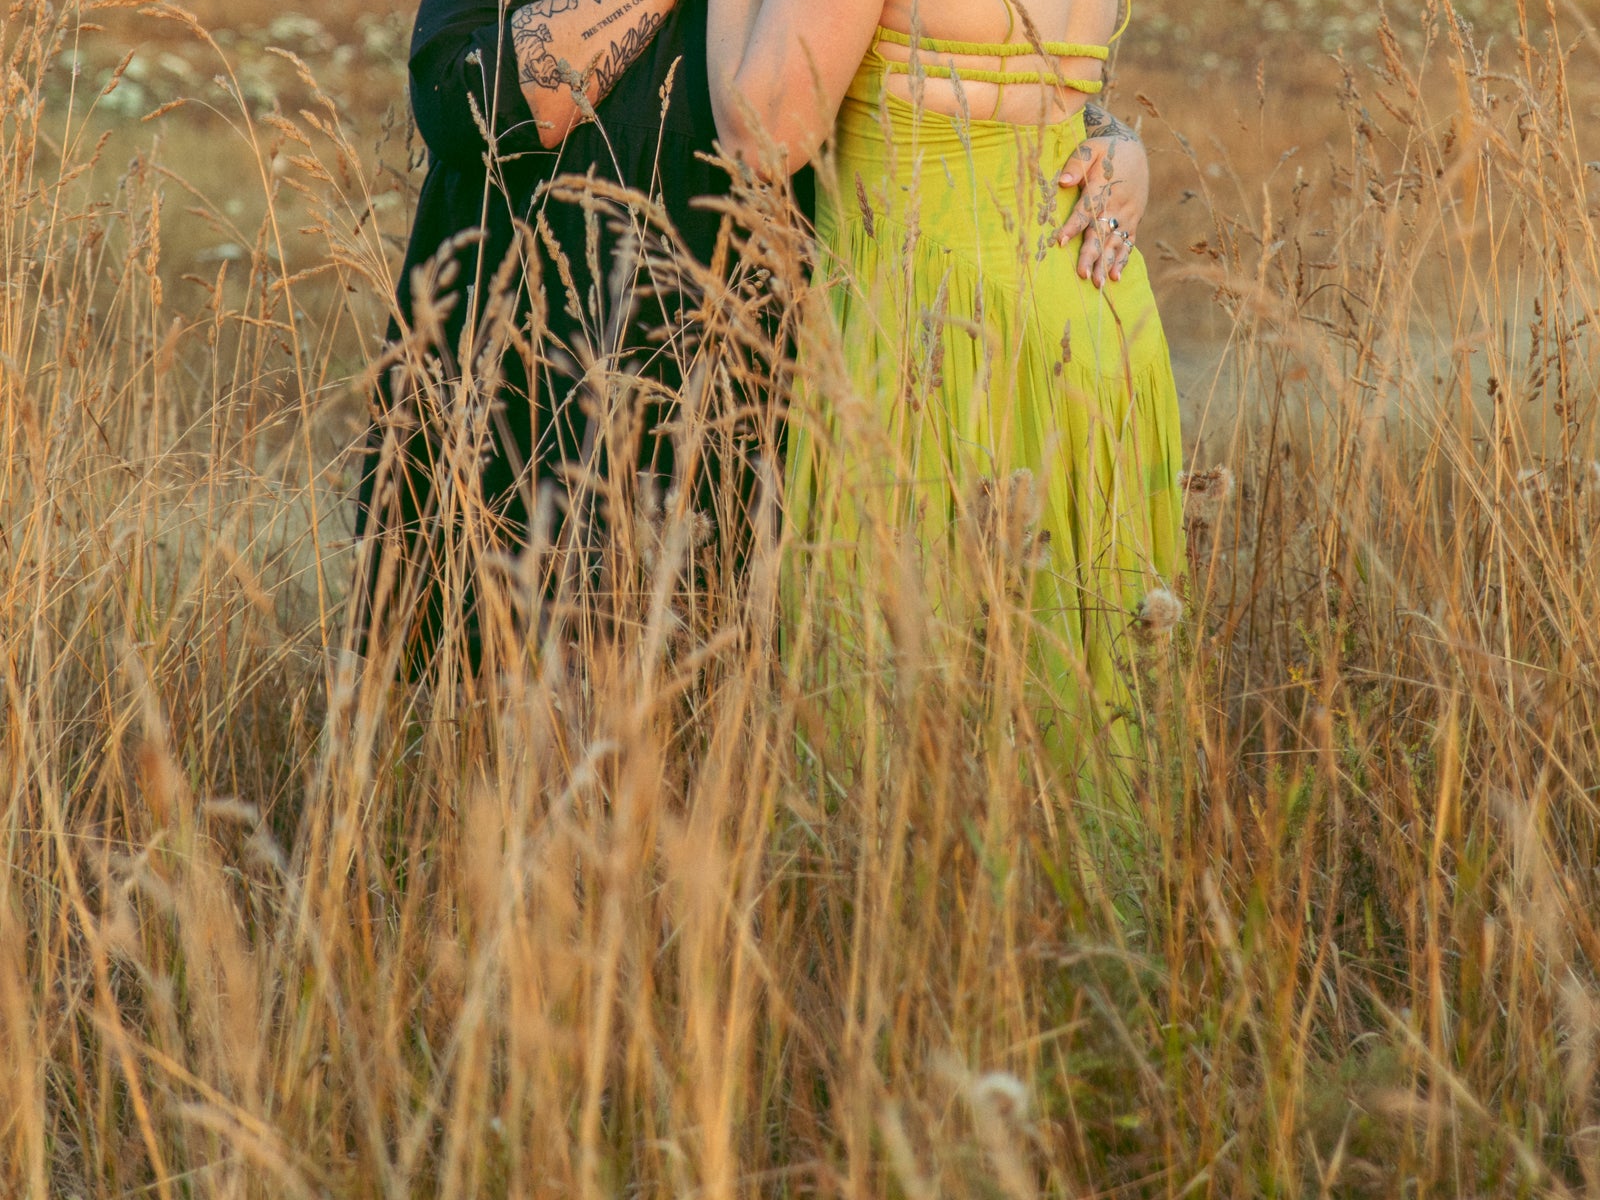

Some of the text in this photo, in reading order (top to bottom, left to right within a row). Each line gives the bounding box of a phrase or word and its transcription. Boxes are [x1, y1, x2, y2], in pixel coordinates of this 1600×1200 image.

[581, 26, 598, 40] THE
[597, 8, 624, 29] TRUTH
[622, 2, 632, 12] IS
